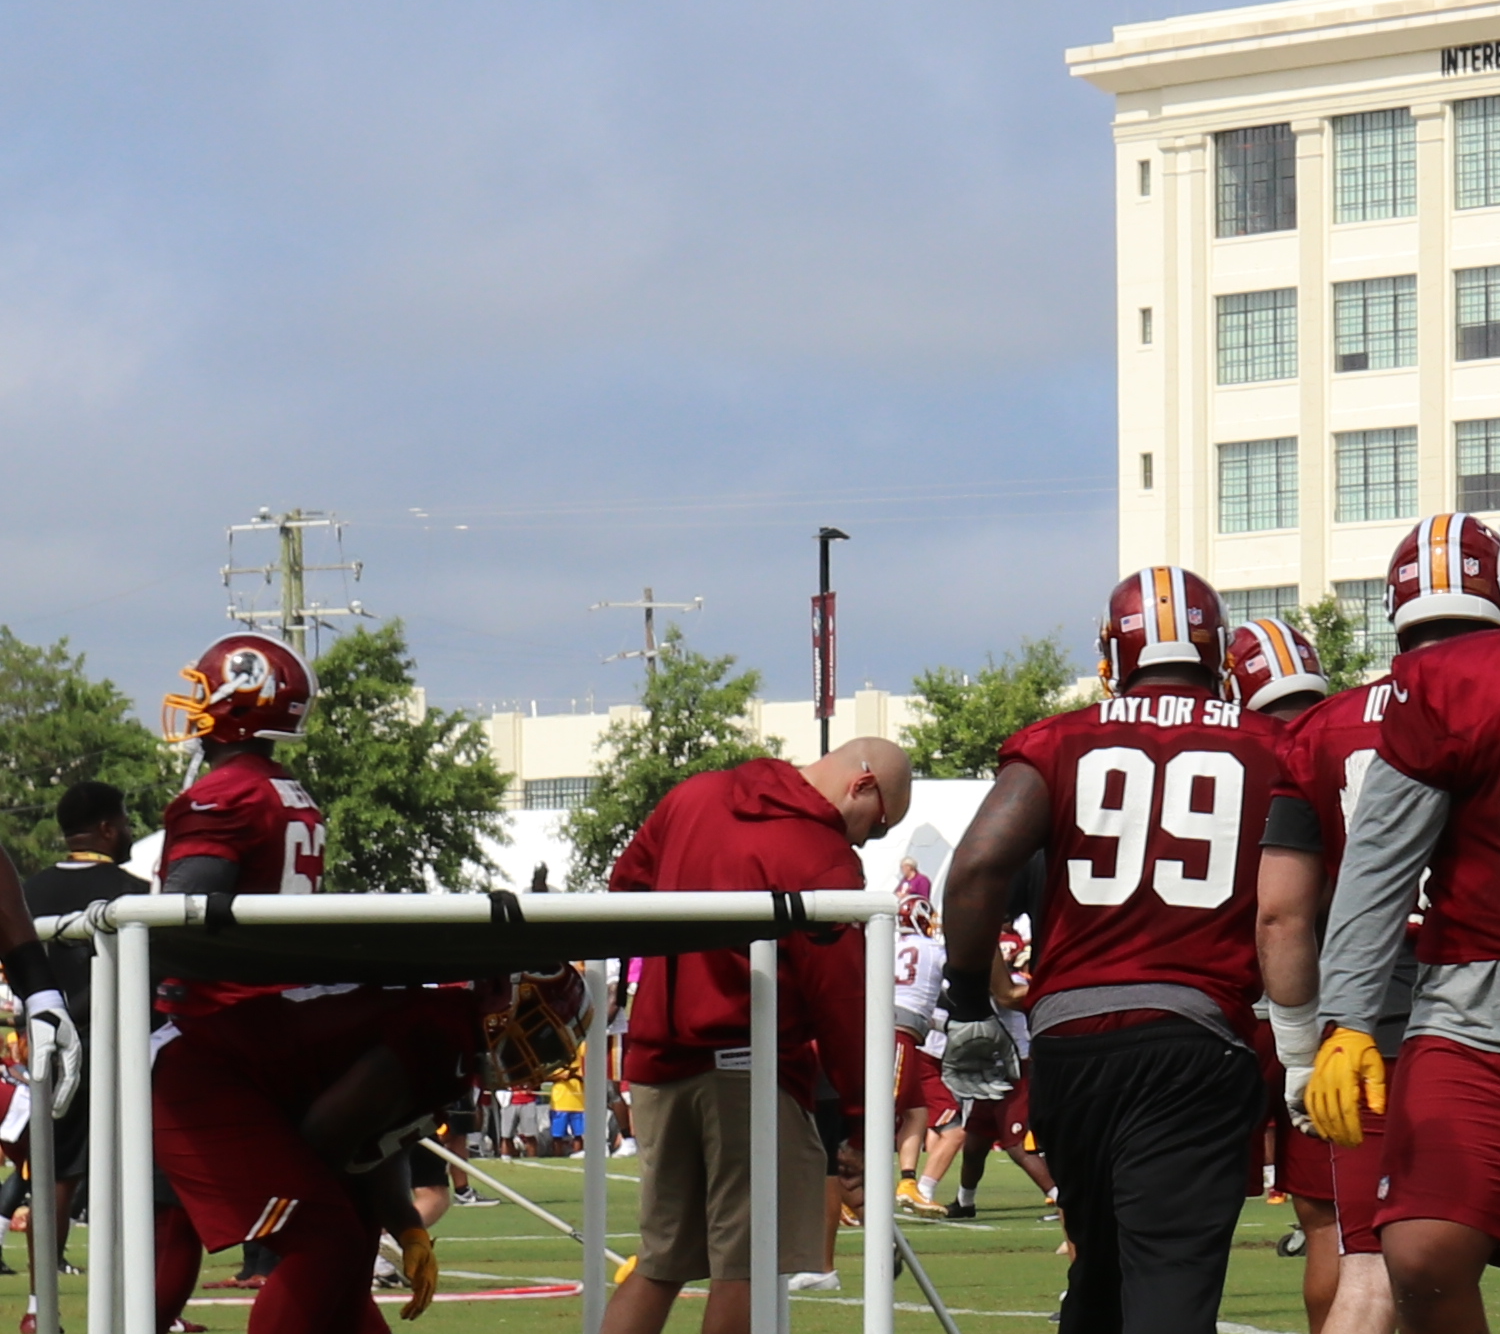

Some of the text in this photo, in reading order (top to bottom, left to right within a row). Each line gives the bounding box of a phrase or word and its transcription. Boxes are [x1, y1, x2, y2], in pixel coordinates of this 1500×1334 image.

[1099, 695, 1242, 728] TAYLOR SR
[1067, 746, 1245, 909] 99
